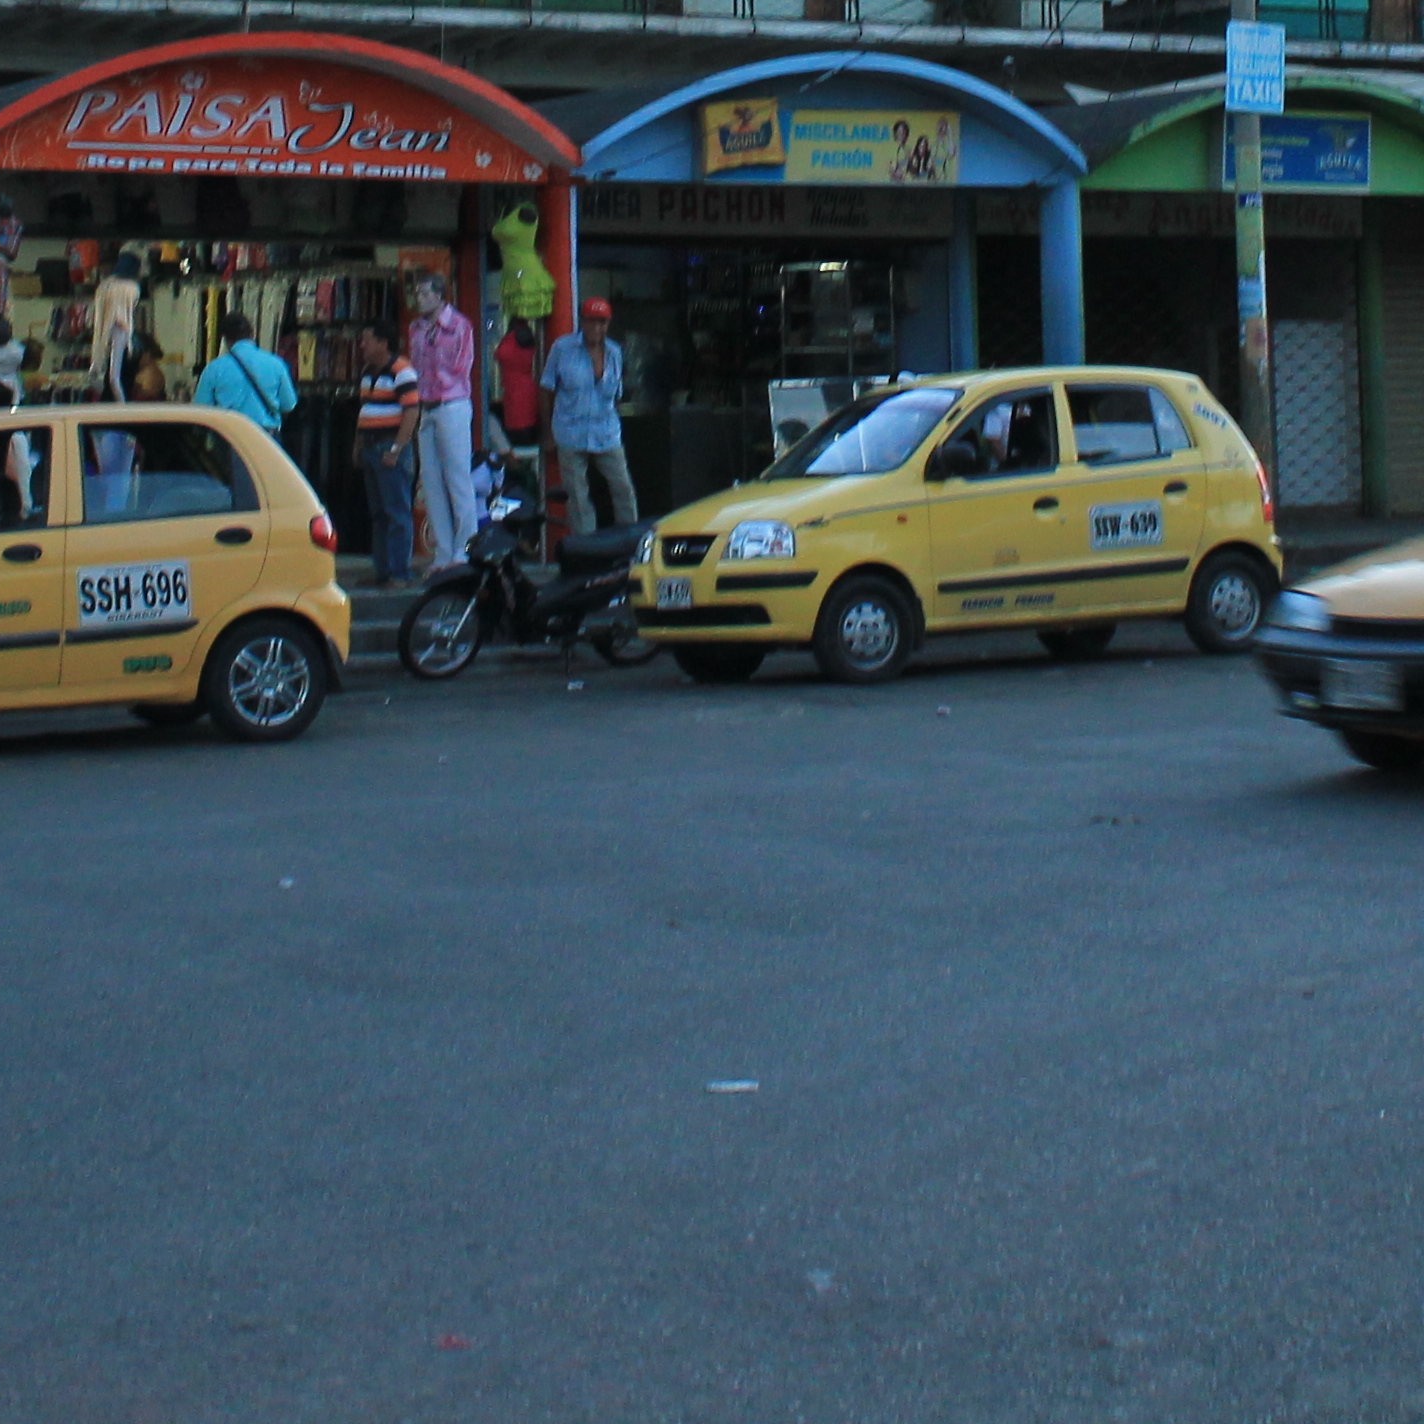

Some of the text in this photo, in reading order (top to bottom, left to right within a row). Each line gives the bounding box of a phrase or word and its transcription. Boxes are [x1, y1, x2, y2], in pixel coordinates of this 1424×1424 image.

[1233, 79, 1282, 103] TAXIS
[287, 100, 450, 156] Jean
[795, 122, 891, 143] MISCELANEA
[87, 153, 447, 180] Ropa para Toda la Familia
[811, 148, 873, 169] PACHÓN
[81, 567, 187, 614] SSH 696
